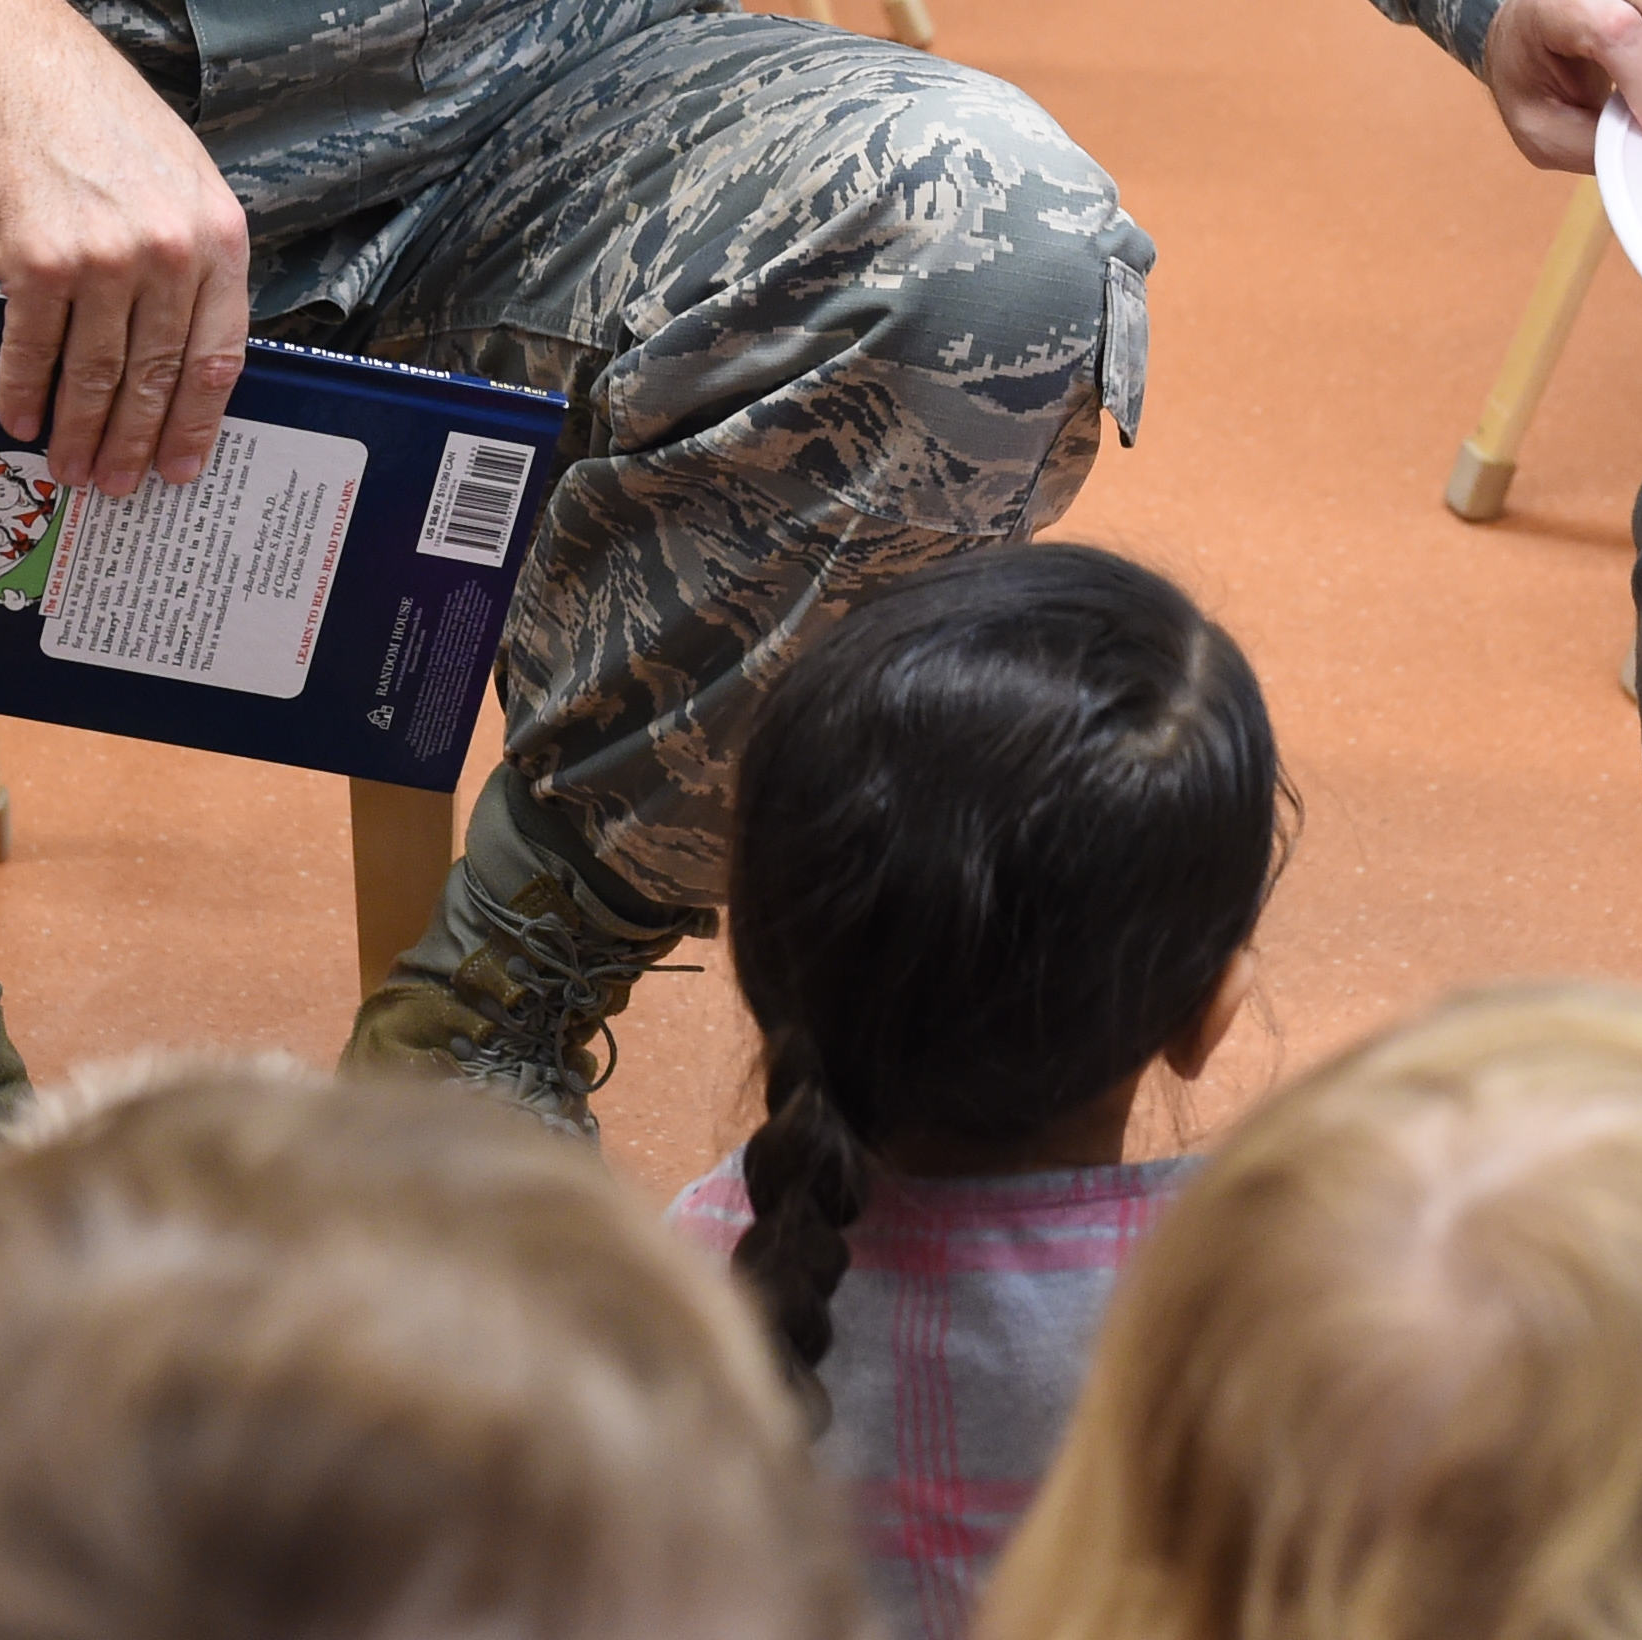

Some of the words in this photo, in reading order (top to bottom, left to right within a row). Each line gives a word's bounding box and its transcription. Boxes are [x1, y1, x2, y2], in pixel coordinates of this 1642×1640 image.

[283, 342, 306, 353] No
[311, 346, 354, 362] Place
[359, 356, 393, 369] Like
[230, 432, 244, 444] be
[242, 435, 258, 460] time.
[206, 428, 231, 478] Learning
[227, 447, 240, 465] can
[216, 467, 234, 496] books
[236, 464, 251, 490] same
[198, 482, 215, 510] Hat's
[228, 493, 243, 511] the
[278, 468, 300, 513] Professor
[334, 477, 357, 520] LEARN.
[424, 526, 436, 540] US
[443, 450, 457, 471] CAN
[65, 489, 88, 529] Learning
[121, 498, 135, 516] the
[151, 498, 165, 515] the
[211, 498, 226, 519] that
[303, 481, 328, 531] University
[96, 508, 118, 555] nonfiction
[116, 520, 129, 532] in
[144, 516, 161, 544] about
[192, 514, 207, 533] the
[226, 515, 237, 526] at
[271, 513, 288, 540] Huck
[329, 521, 344, 539] TO
[59, 530, 76, 552] Hat's
[78, 522, 99, 562] between
[110, 536, 125, 555] Cat
[111, 579, 129, 607] books
[121, 528, 143, 575] introduce
[134, 475, 159, 525] beginning
[176, 526, 189, 544] can
[187, 538, 200, 550] in
[201, 521, 220, 558] readers
[268, 540, 280, 551] S.
[296, 531, 313, 557] State
[55, 553, 69, 569] the
[91, 556, 105, 576] and
[134, 544, 155, 585] concepts
[151, 542, 169, 577] critical
[166, 546, 183, 573] ideas
[181, 555, 196, 575] Cat
[208, 529, 233, 585] educational
[273, 538, 296, 588] Children's
[320, 539, 339, 572] READ
[52, 569, 65, 579] in
[76, 562, 90, 582] gap
[104, 558, 119, 579] The
[194, 560, 212, 591] young
[256, 551, 277, 596] Charlotte
[290, 557, 306, 582] Ohio
[48, 580, 63, 597] Cat
[68, 581, 85, 599] big
[126, 584, 143, 609] basic
[145, 578, 159, 595] the
[162, 574, 175, 594] and
[173, 579, 189, 600] The
[271, 586, 285, 599] of
[284, 581, 299, 600] The
[310, 572, 330, 608] READ.
[42, 597, 58, 615] The
[75, 576, 101, 635] preschoolers
[153, 597, 169, 621] facts
[184, 592, 201, 622] shows
[203, 588, 217, 608] and
[212, 584, 234, 632] wonderful
[64, 608, 76, 617] is
[136, 597, 156, 634] provide
[305, 608, 320, 626] TO
[55, 618, 74, 647] There
[86, 614, 106, 652] reading
[115, 610, 137, 658] important
[162, 605, 184, 648] addition,
[70, 634, 84, 649] for
[127, 635, 146, 660] They
[143, 623, 163, 663] complex
[186, 610, 213, 670] entertaining
[205, 640, 218, 650] is
[295, 626, 315, 666] LEARN
[374, 641, 401, 697] RANDOM
[390, 595, 414, 640] HOUSE
[156, 653, 170, 665] In
[199, 650, 215, 672] This
